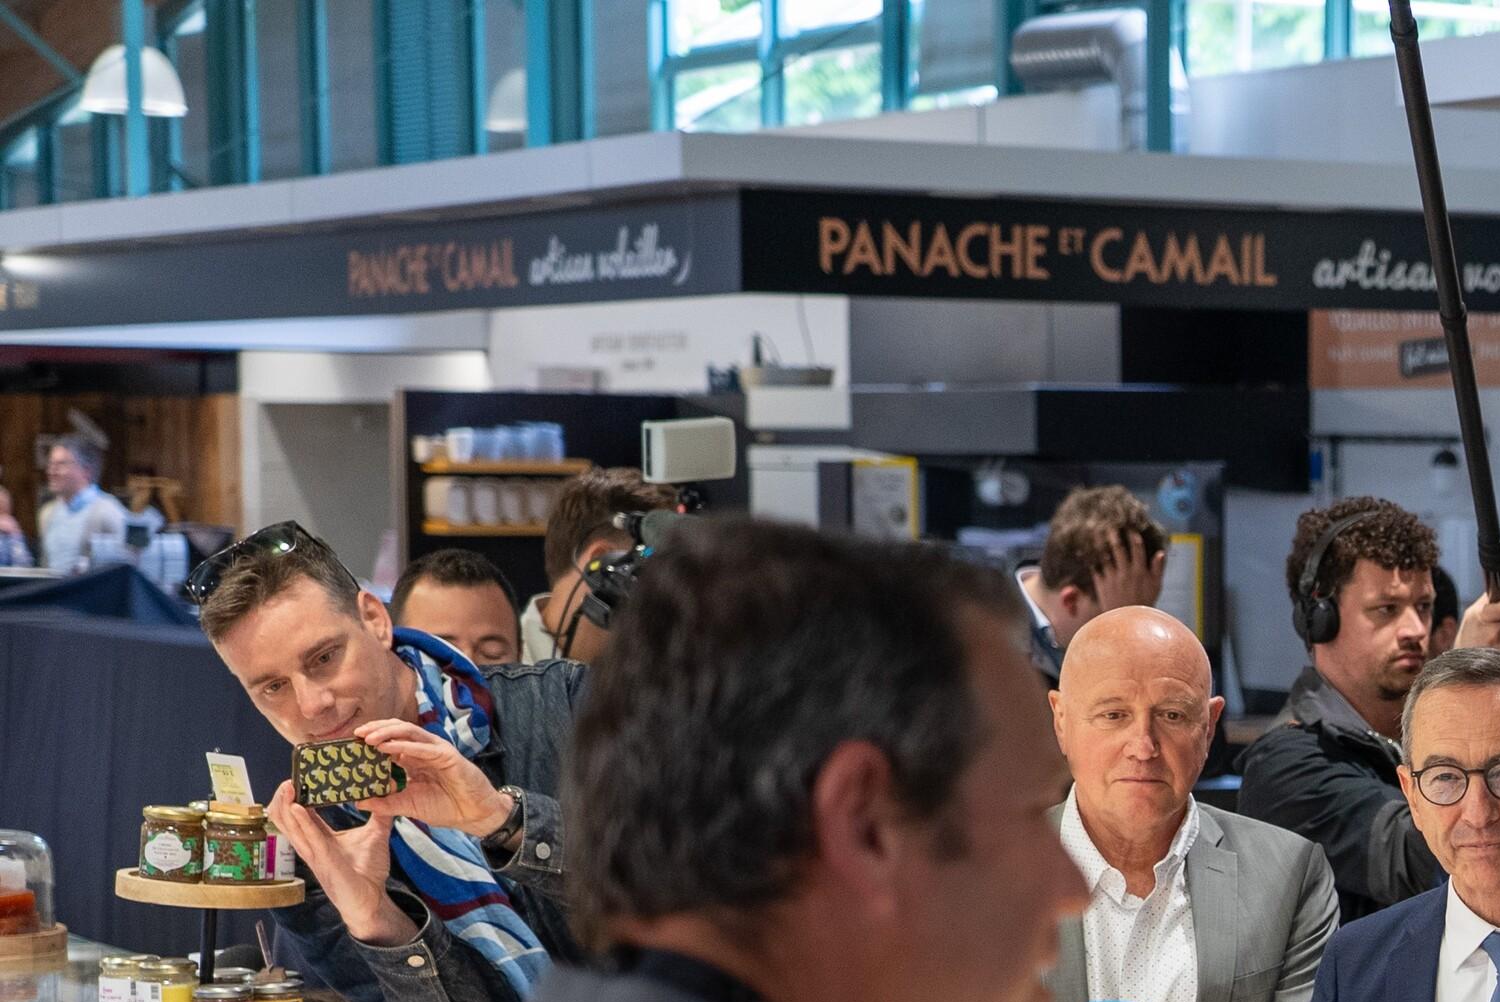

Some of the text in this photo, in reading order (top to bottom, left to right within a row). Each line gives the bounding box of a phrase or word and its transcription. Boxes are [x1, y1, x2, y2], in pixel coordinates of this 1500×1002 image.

[818, 216, 1051, 281] PANACHE
[1058, 227, 1087, 255] ET
[1089, 227, 1279, 287] CAMAIL
[1312, 239, 1438, 291] artisa
